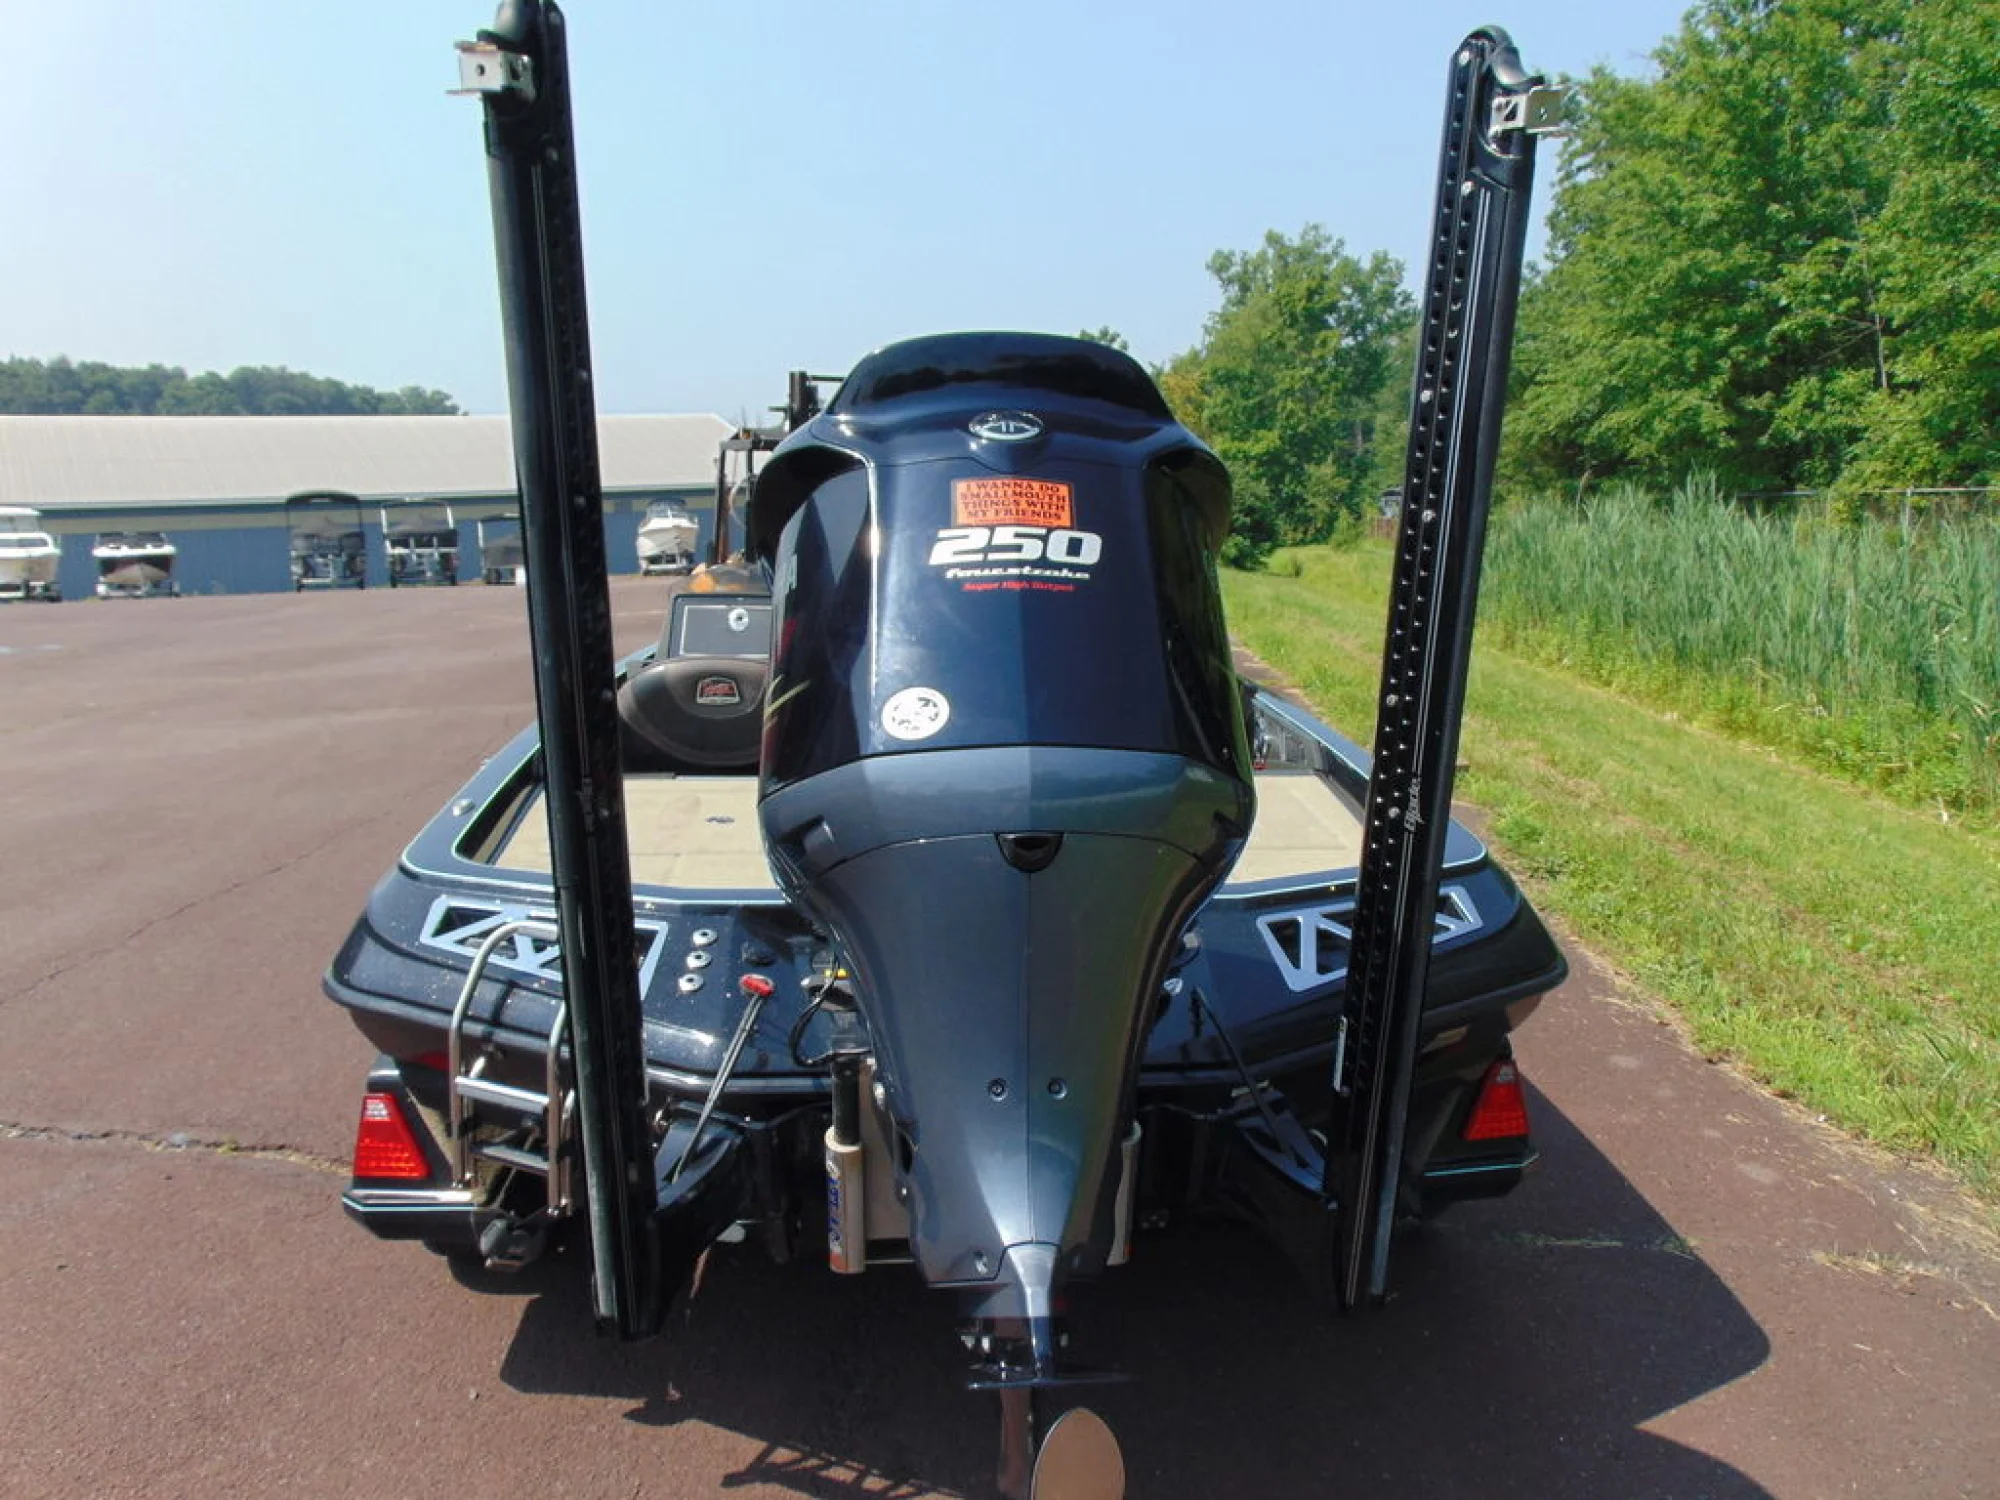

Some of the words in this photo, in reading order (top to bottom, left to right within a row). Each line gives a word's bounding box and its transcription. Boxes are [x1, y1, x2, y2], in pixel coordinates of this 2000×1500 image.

[976, 481, 1034, 491] WANNA
[1039, 483, 1060, 493] DO
[960, 490, 1067, 503] SMALLMOUTH
[963, 499, 1021, 510] THINGS
[1025, 500, 1066, 512] WITH
[994, 509, 1062, 520] FRIENDS
[928, 526, 1103, 565] 250
[961, 582, 1000, 593] Super
